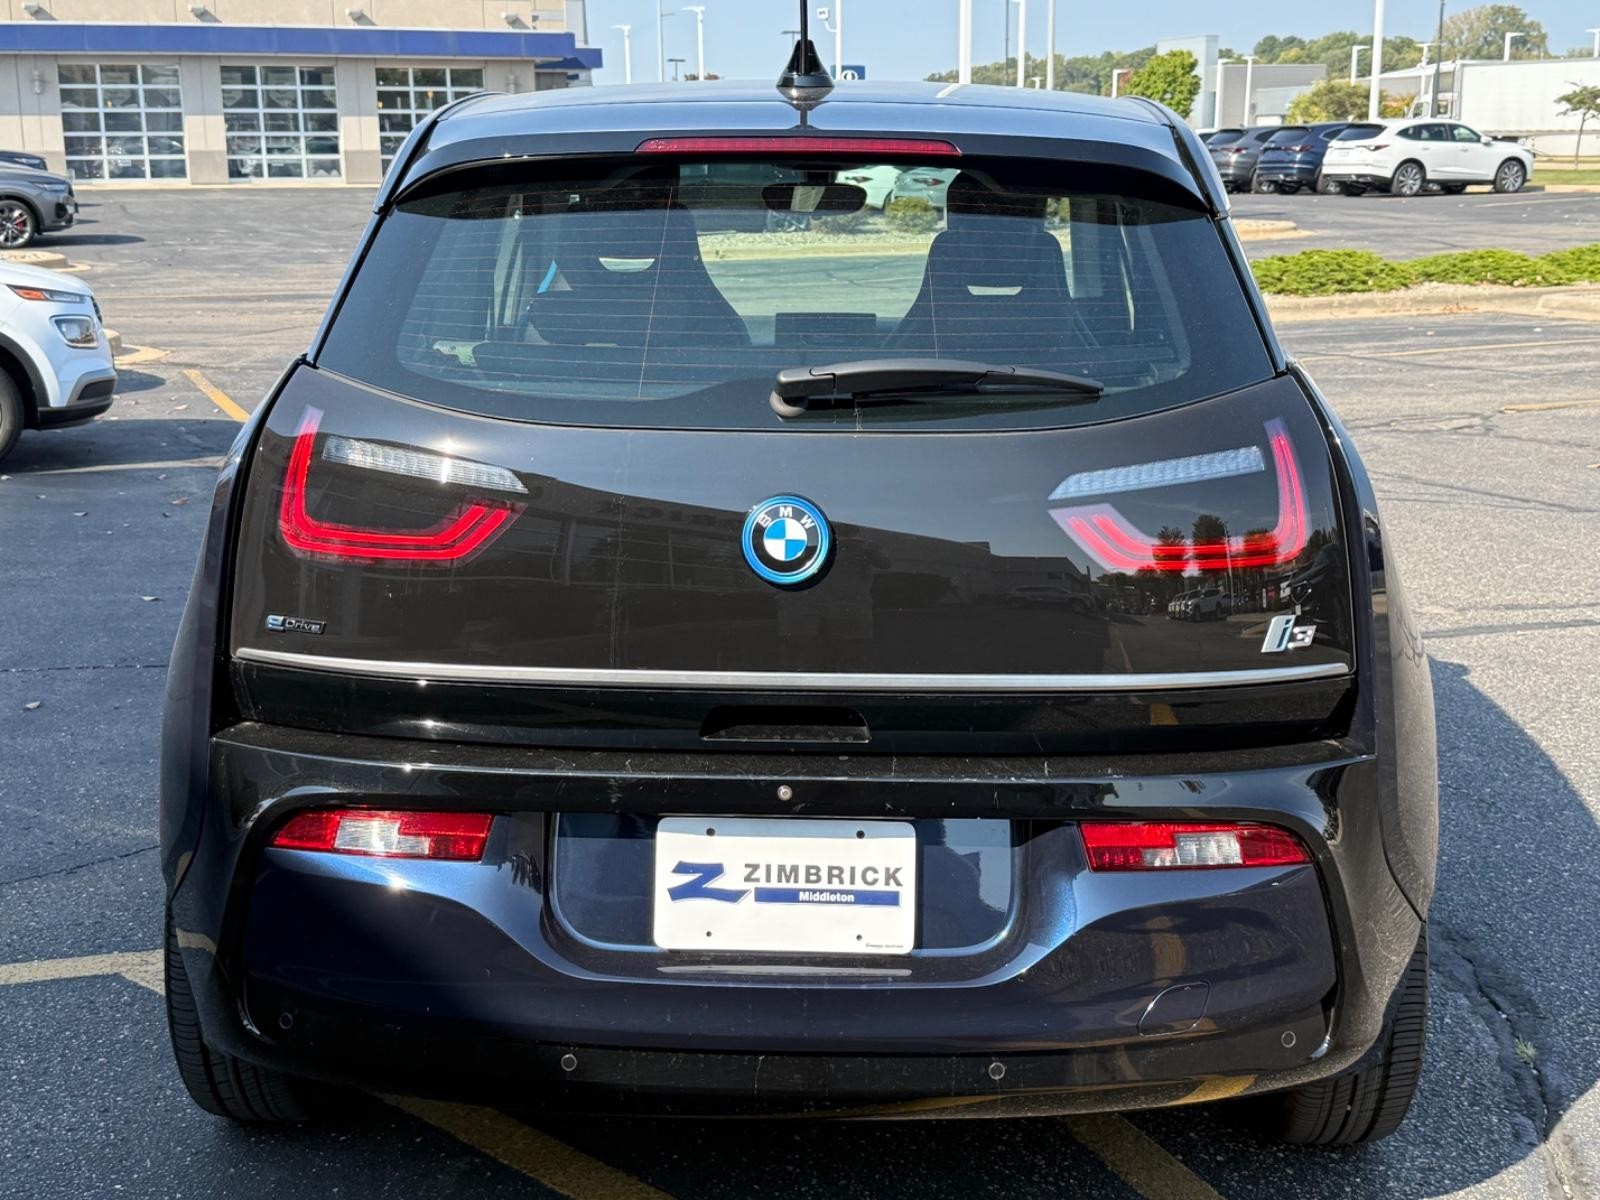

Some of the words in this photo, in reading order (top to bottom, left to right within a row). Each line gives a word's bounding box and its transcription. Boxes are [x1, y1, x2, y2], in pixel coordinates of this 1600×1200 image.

[758, 506, 815, 528] BMW
[1260, 614, 1317, 653] i3
[743, 863, 903, 887] ZIMBRICK
[799, 890, 855, 903] Middleton
